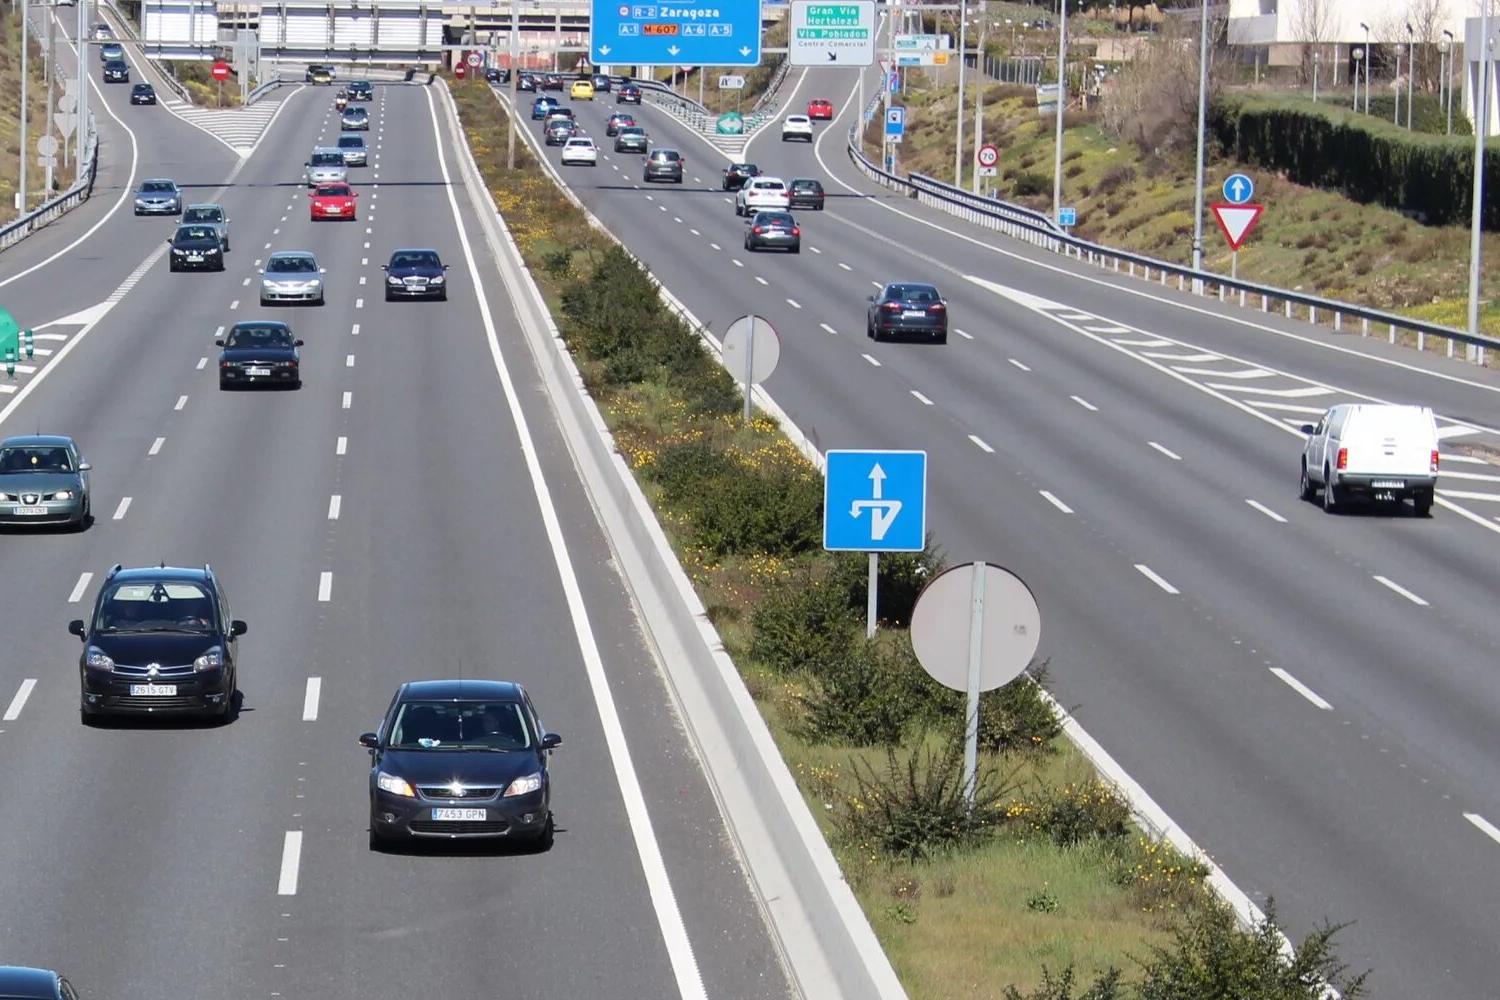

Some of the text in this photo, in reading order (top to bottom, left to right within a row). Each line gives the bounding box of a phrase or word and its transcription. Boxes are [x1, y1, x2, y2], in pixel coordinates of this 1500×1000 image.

[634, 7, 720, 20] R-2 Zaragoza
[810, 6, 834, 15] Gran
[807, 16, 858, 25] Hortaleza
[621, 25, 638, 34] A-1
[643, 25, 677, 34] M-607
[684, 25, 704, 34] A-6
[711, 25, 731, 34] A-5
[821, 29, 867, 38] Poblados
[798, 40, 867, 48] Centro Comercial
[982, 152, 995, 161] 70
[437, 809, 485, 820] 7453 GPN
